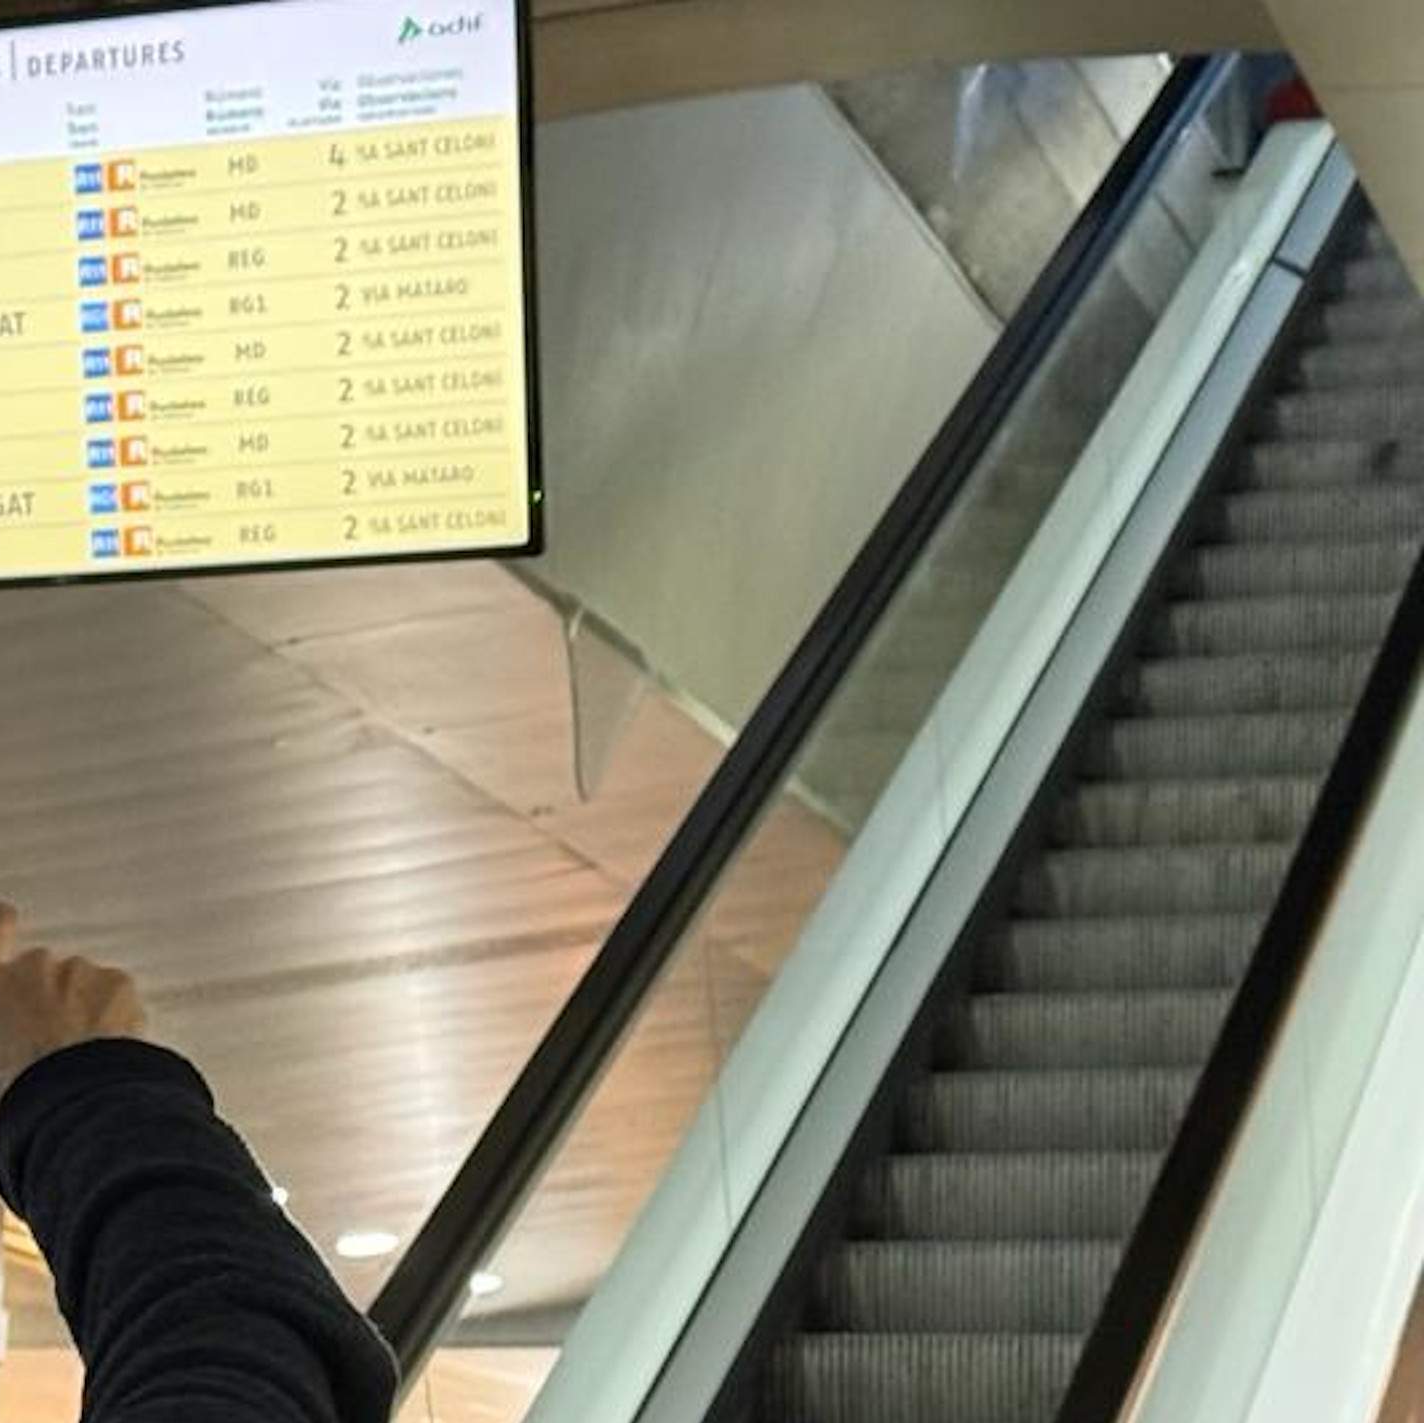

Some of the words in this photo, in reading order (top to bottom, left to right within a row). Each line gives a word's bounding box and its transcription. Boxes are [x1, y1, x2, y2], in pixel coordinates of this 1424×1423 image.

[27, 41, 185, 77] DEPARTURES
[229, 156, 258, 176] MD
[329, 143, 346, 168] 4
[385, 139, 427, 158] SANT
[231, 203, 260, 223] MD
[332, 192, 347, 216] 2
[386, 186, 428, 206] SANT
[335, 239, 348, 263] 2
[388, 233, 430, 253] SANT
[336, 286, 350, 311] 2
[236, 342, 266, 361] MD
[337, 333, 350, 355] 2
[391, 328, 434, 349] SANT
[339, 380, 353, 402] 2
[392, 374, 435, 393] SANT
[239, 435, 268, 453] MD
[341, 426, 355, 448] 2
[394, 421, 436, 440] SANT
[343, 471, 357, 495] 2
[344, 517, 358, 540] 2
[397, 514, 439, 532] SANT
